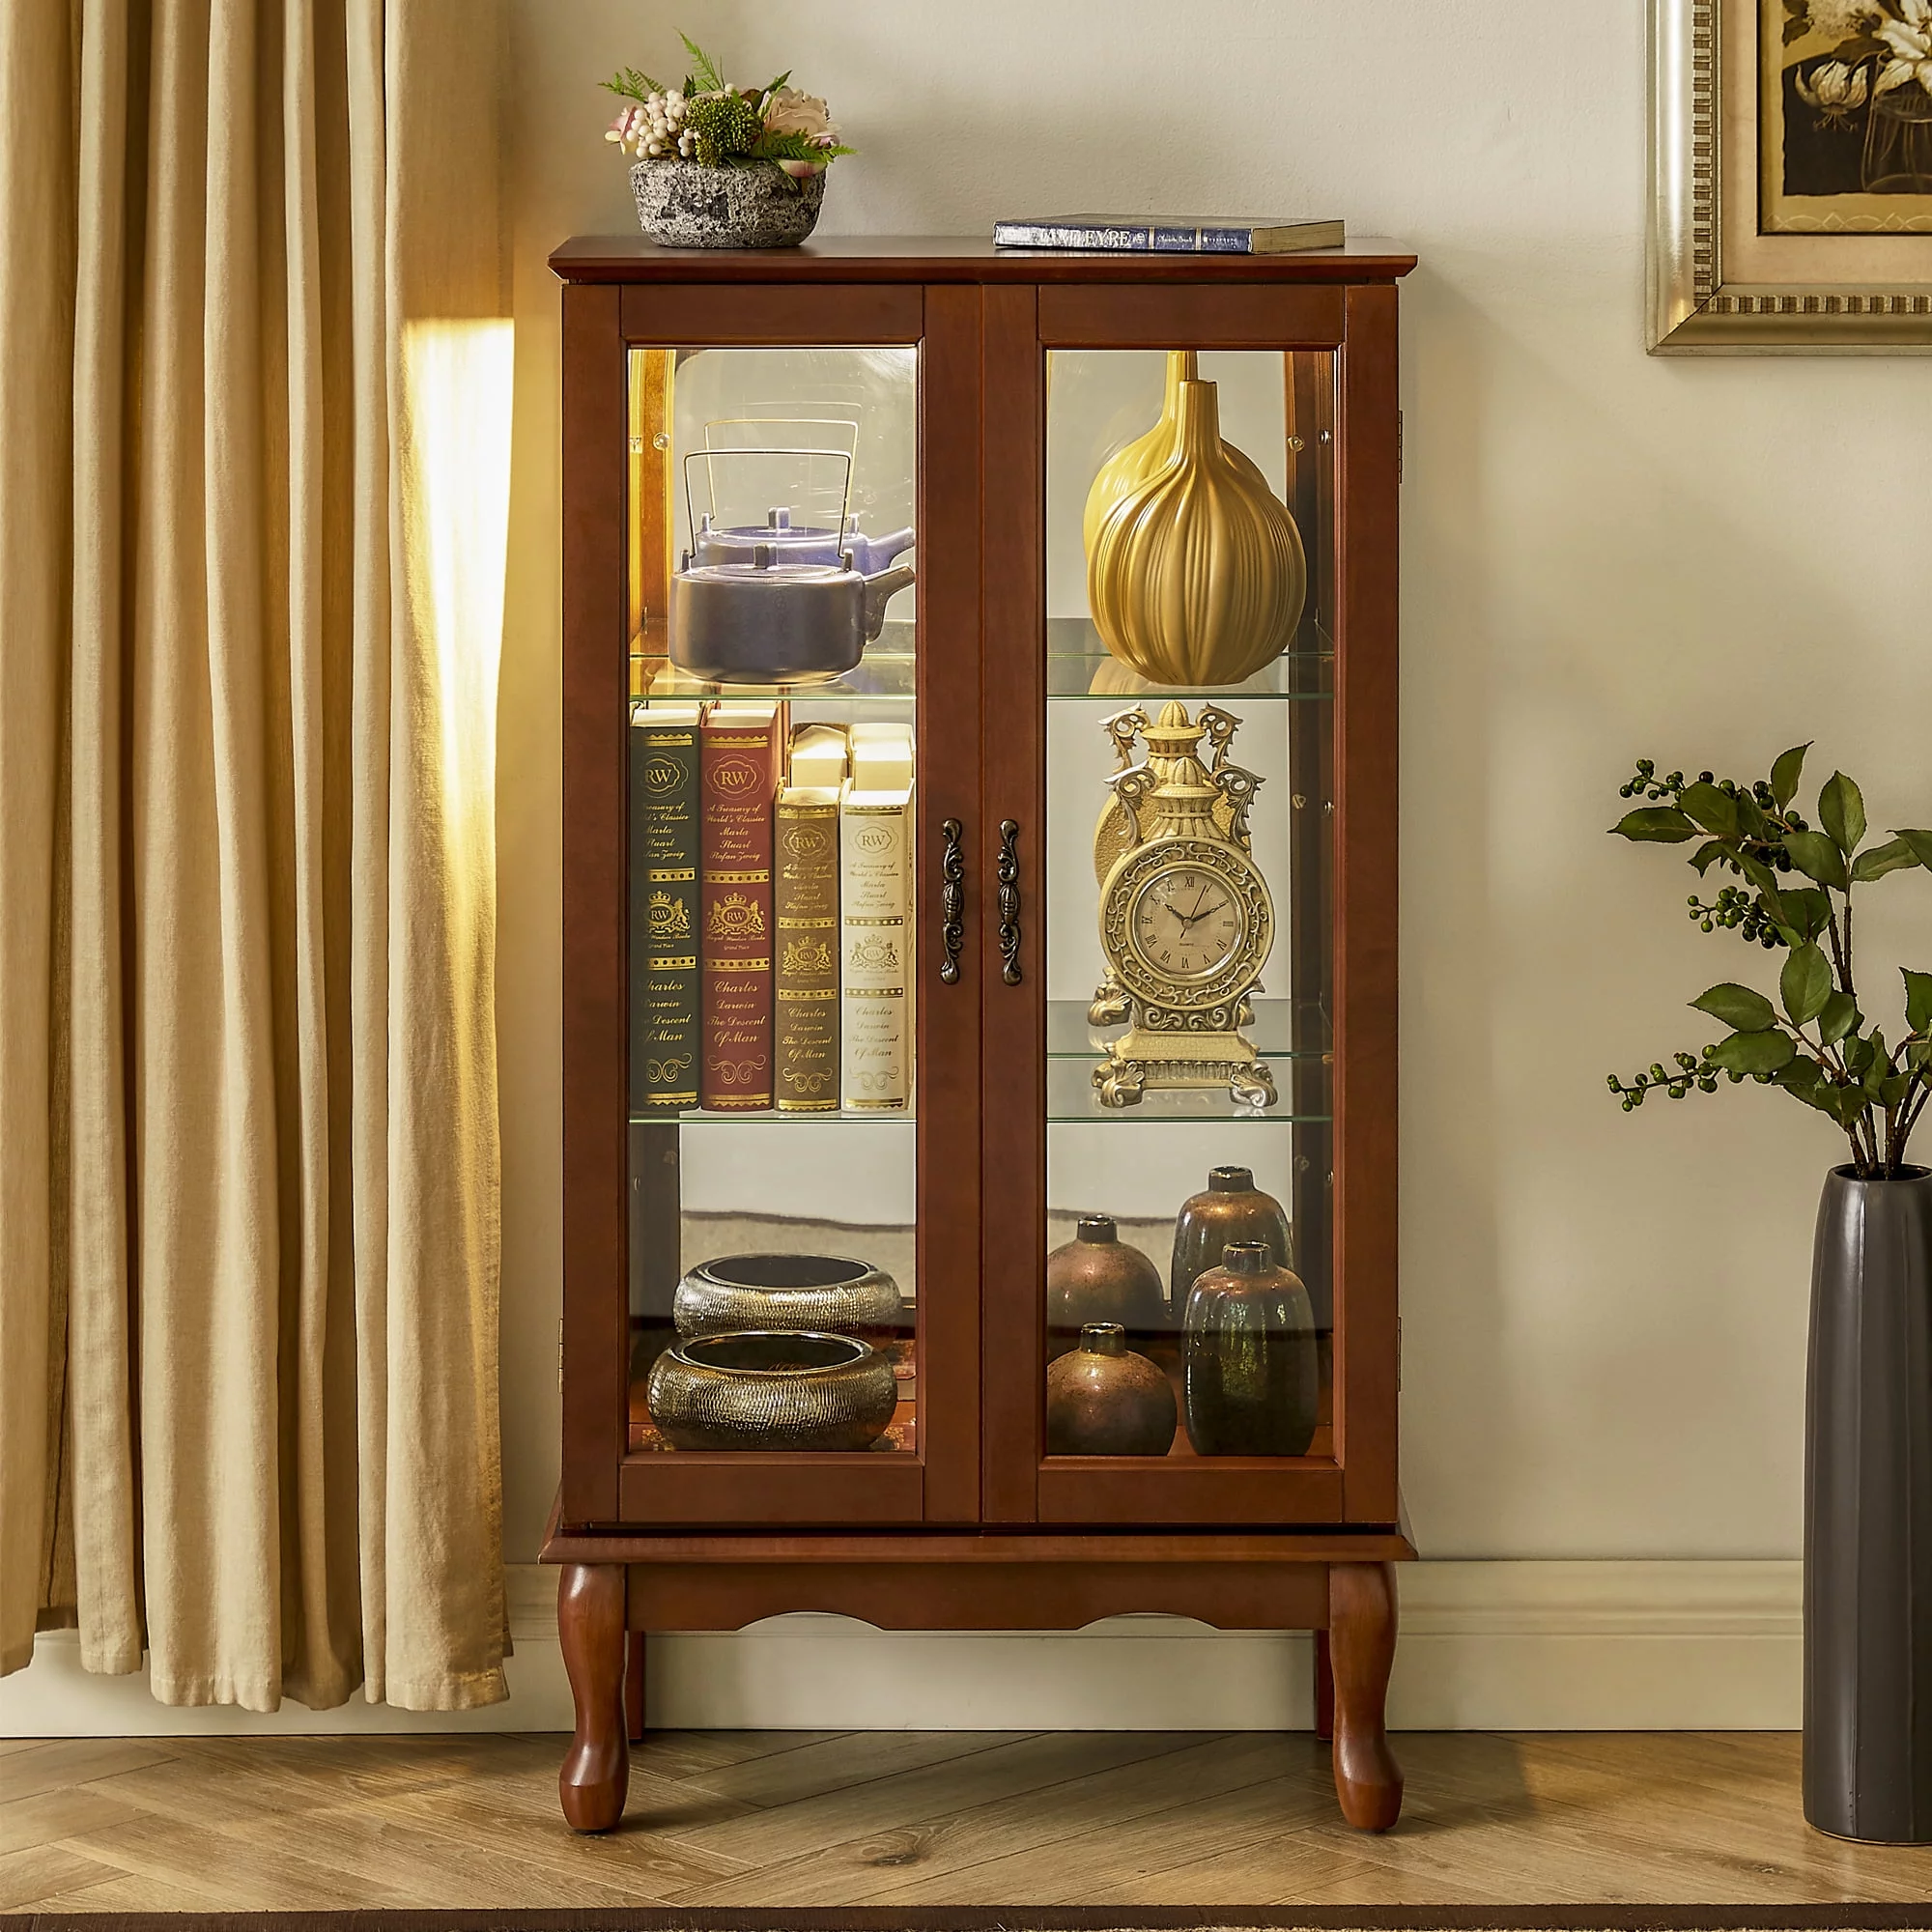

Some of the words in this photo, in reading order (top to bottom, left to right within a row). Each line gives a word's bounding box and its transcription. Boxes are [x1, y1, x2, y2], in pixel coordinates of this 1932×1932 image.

[645, 769, 672, 784] RW
[721, 771, 749, 786] RW
[795, 837, 819, 849] RW
[862, 835, 885, 846] RW
[1185, 877, 1194, 887] XII
[651, 910, 669, 920] RW
[727, 912, 744, 921] RW
[1182, 957, 1189, 968] VI
[1203, 954, 1211, 964] V
[648, 980, 685, 991] harles
[714, 980, 759, 992] Charles
[649, 1000, 681, 1008] arwin
[716, 1000, 756, 1009] Darwin
[788, 1008, 826, 1017] Charles
[856, 1006, 893, 1015] Charles
[653, 1014, 691, 1024] Descent
[707, 1015, 725, 1026] The
[728, 1015, 766, 1026] Descent
[790, 1023, 823, 1031] Darwin
[714, 1031, 730, 1047] Of
[728, 1031, 759, 1043] Man
[782, 1035, 797, 1045] The
[788, 1050, 802, 1062] Of
[801, 1050, 825, 1058] Man
